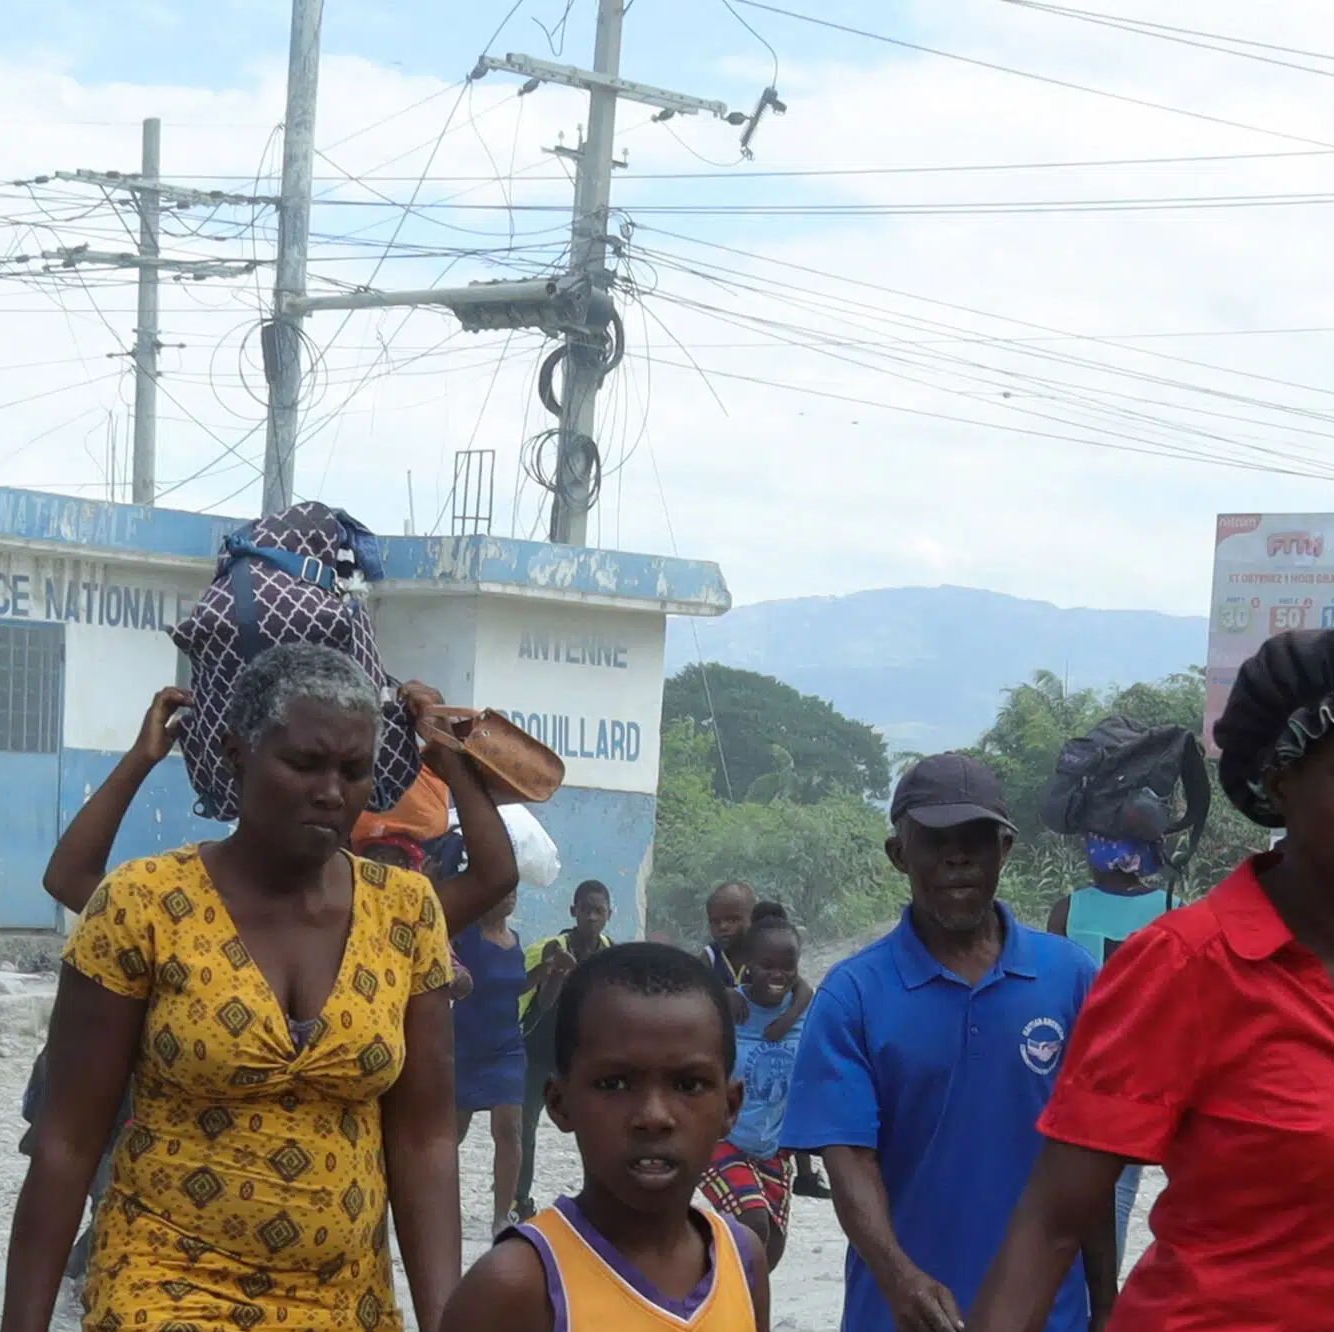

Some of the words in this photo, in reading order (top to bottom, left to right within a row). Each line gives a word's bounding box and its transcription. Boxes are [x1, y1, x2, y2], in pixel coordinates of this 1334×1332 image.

[1275, 607, 1301, 628] 50
[518, 631, 628, 669] ANTENNE
[498, 708, 641, 762] ROUILLARD
